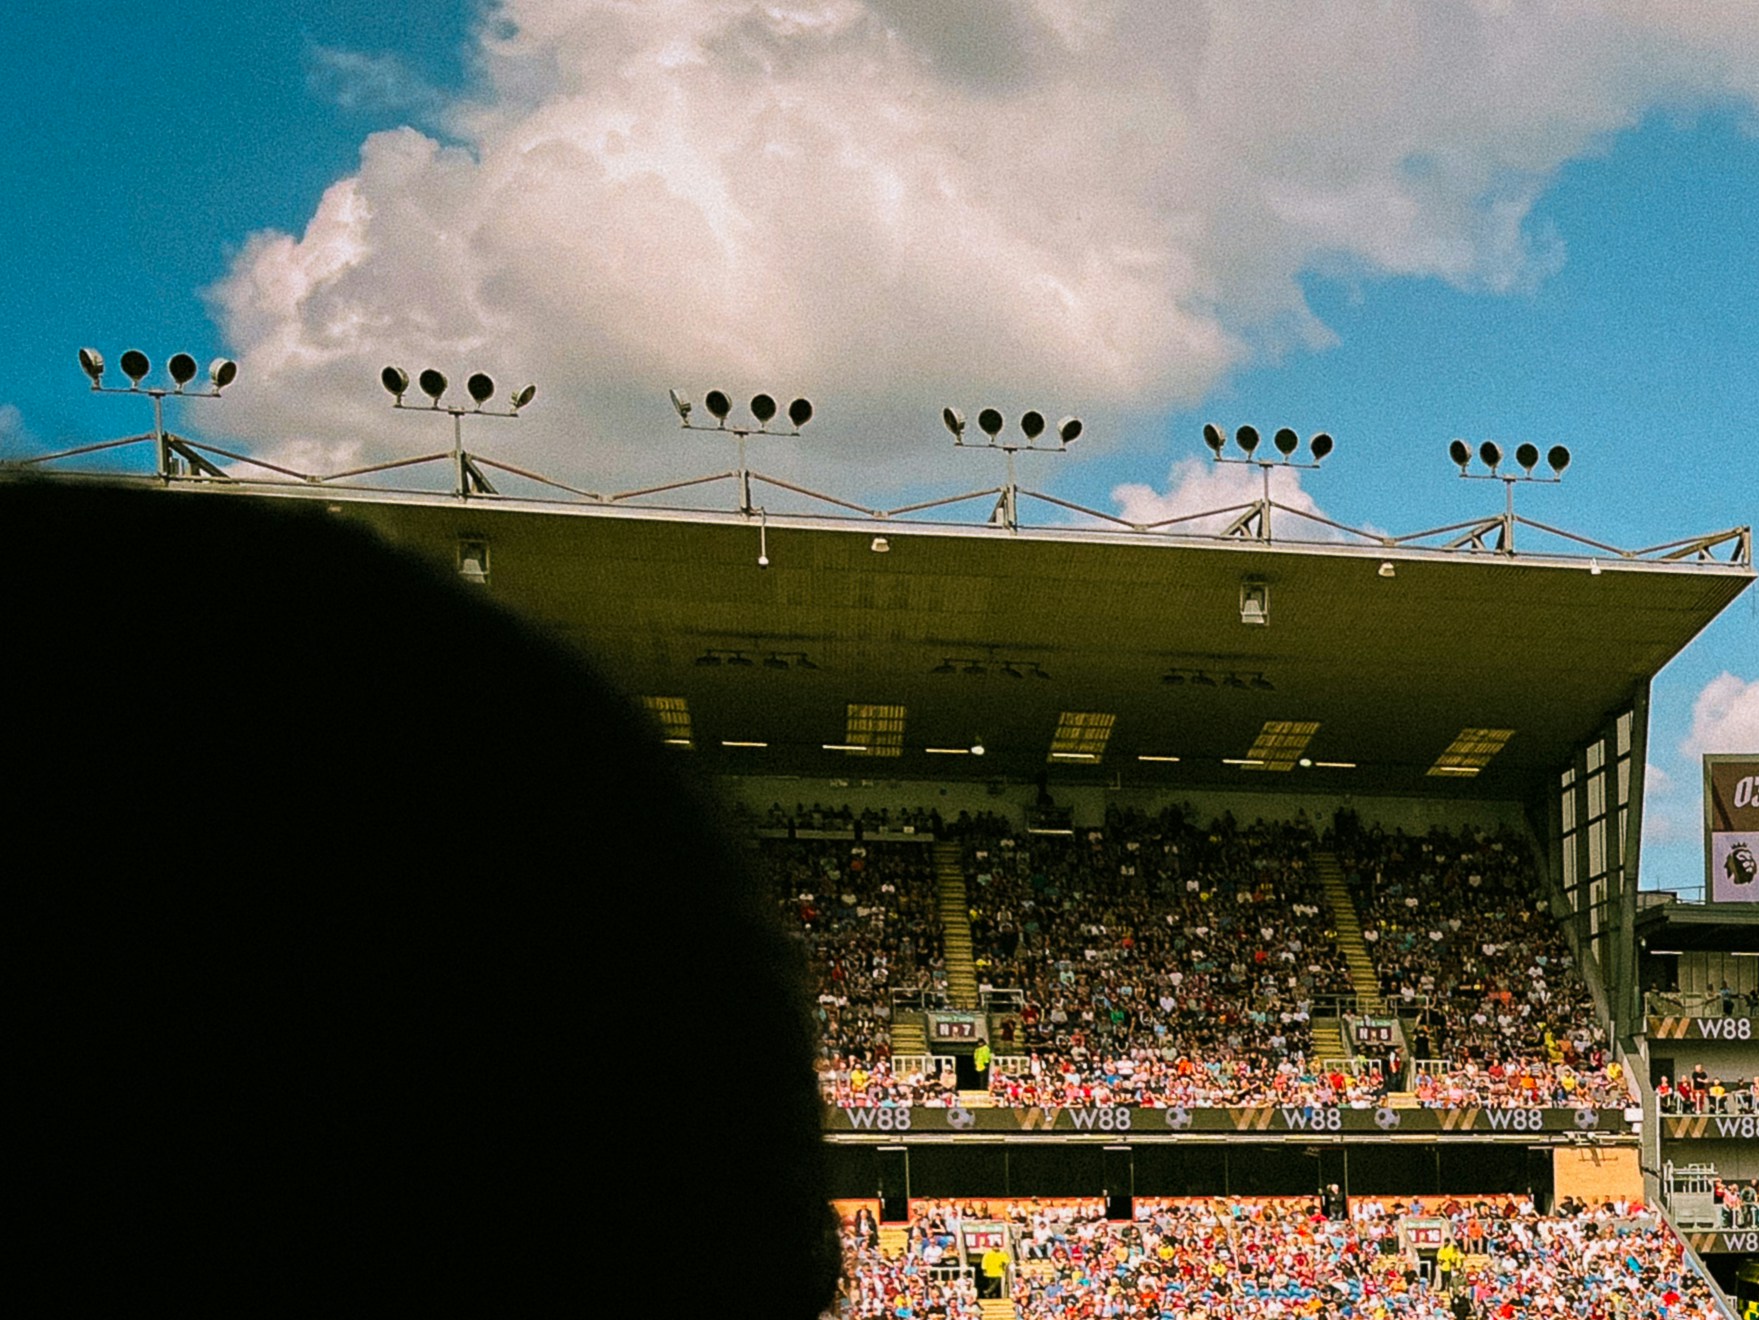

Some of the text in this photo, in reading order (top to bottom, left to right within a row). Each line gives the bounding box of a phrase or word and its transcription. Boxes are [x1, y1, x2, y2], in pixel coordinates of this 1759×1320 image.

[1697, 1018, 1751, 1040] W88
[845, 1107, 911, 1130] W88
[1069, 1107, 1132, 1130] W88
[1283, 1108, 1342, 1131] W88
[1487, 1108, 1544, 1130] W88
